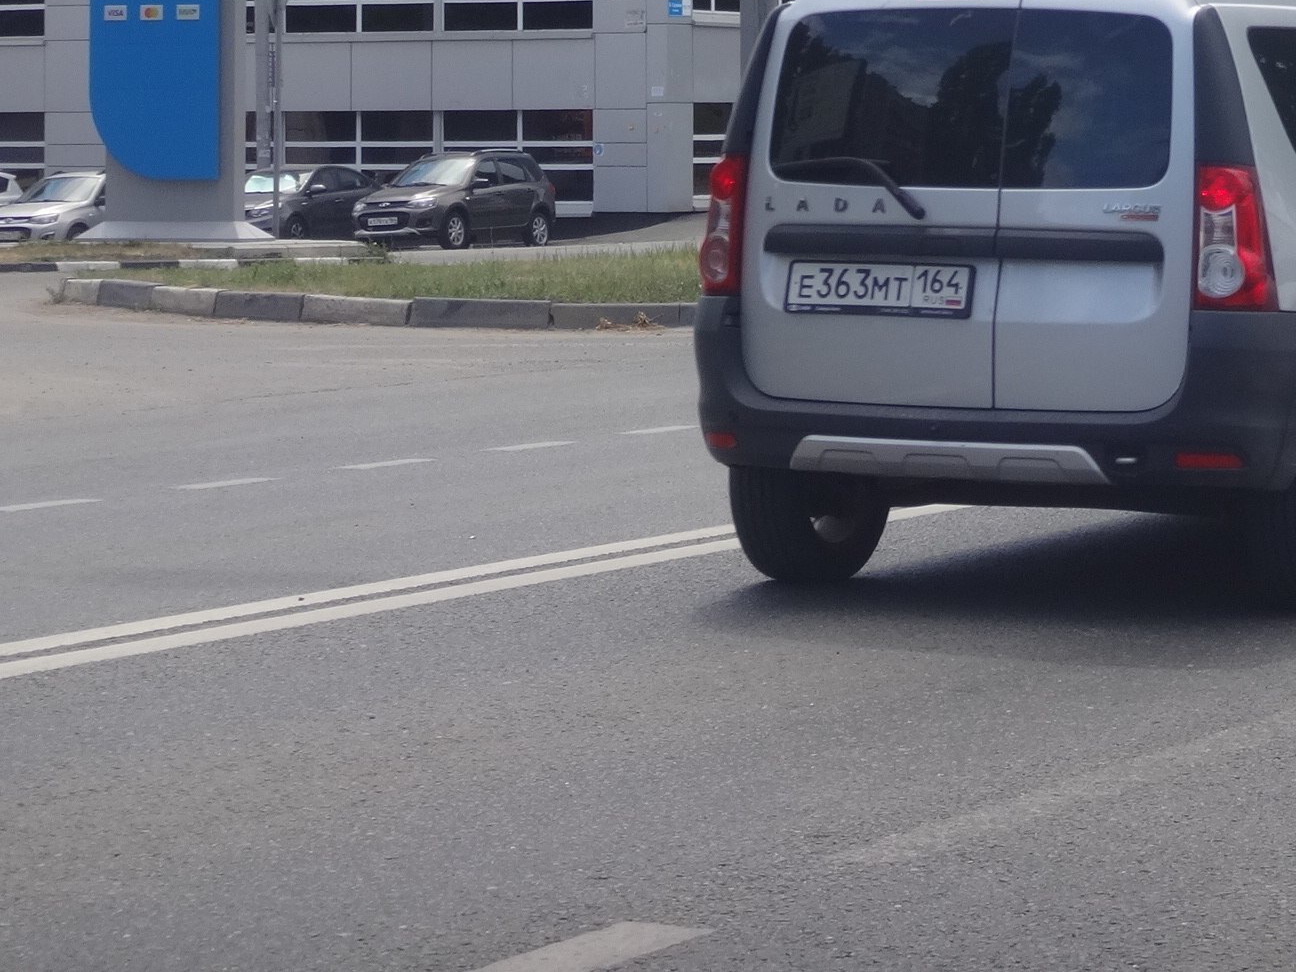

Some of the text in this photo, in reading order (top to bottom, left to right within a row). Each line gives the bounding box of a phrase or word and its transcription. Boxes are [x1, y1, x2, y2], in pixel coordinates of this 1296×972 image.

[764, 196, 886, 214] LADA
[797, 267, 961, 302] Е363МТ 164
[923, 296, 945, 305] RUS
